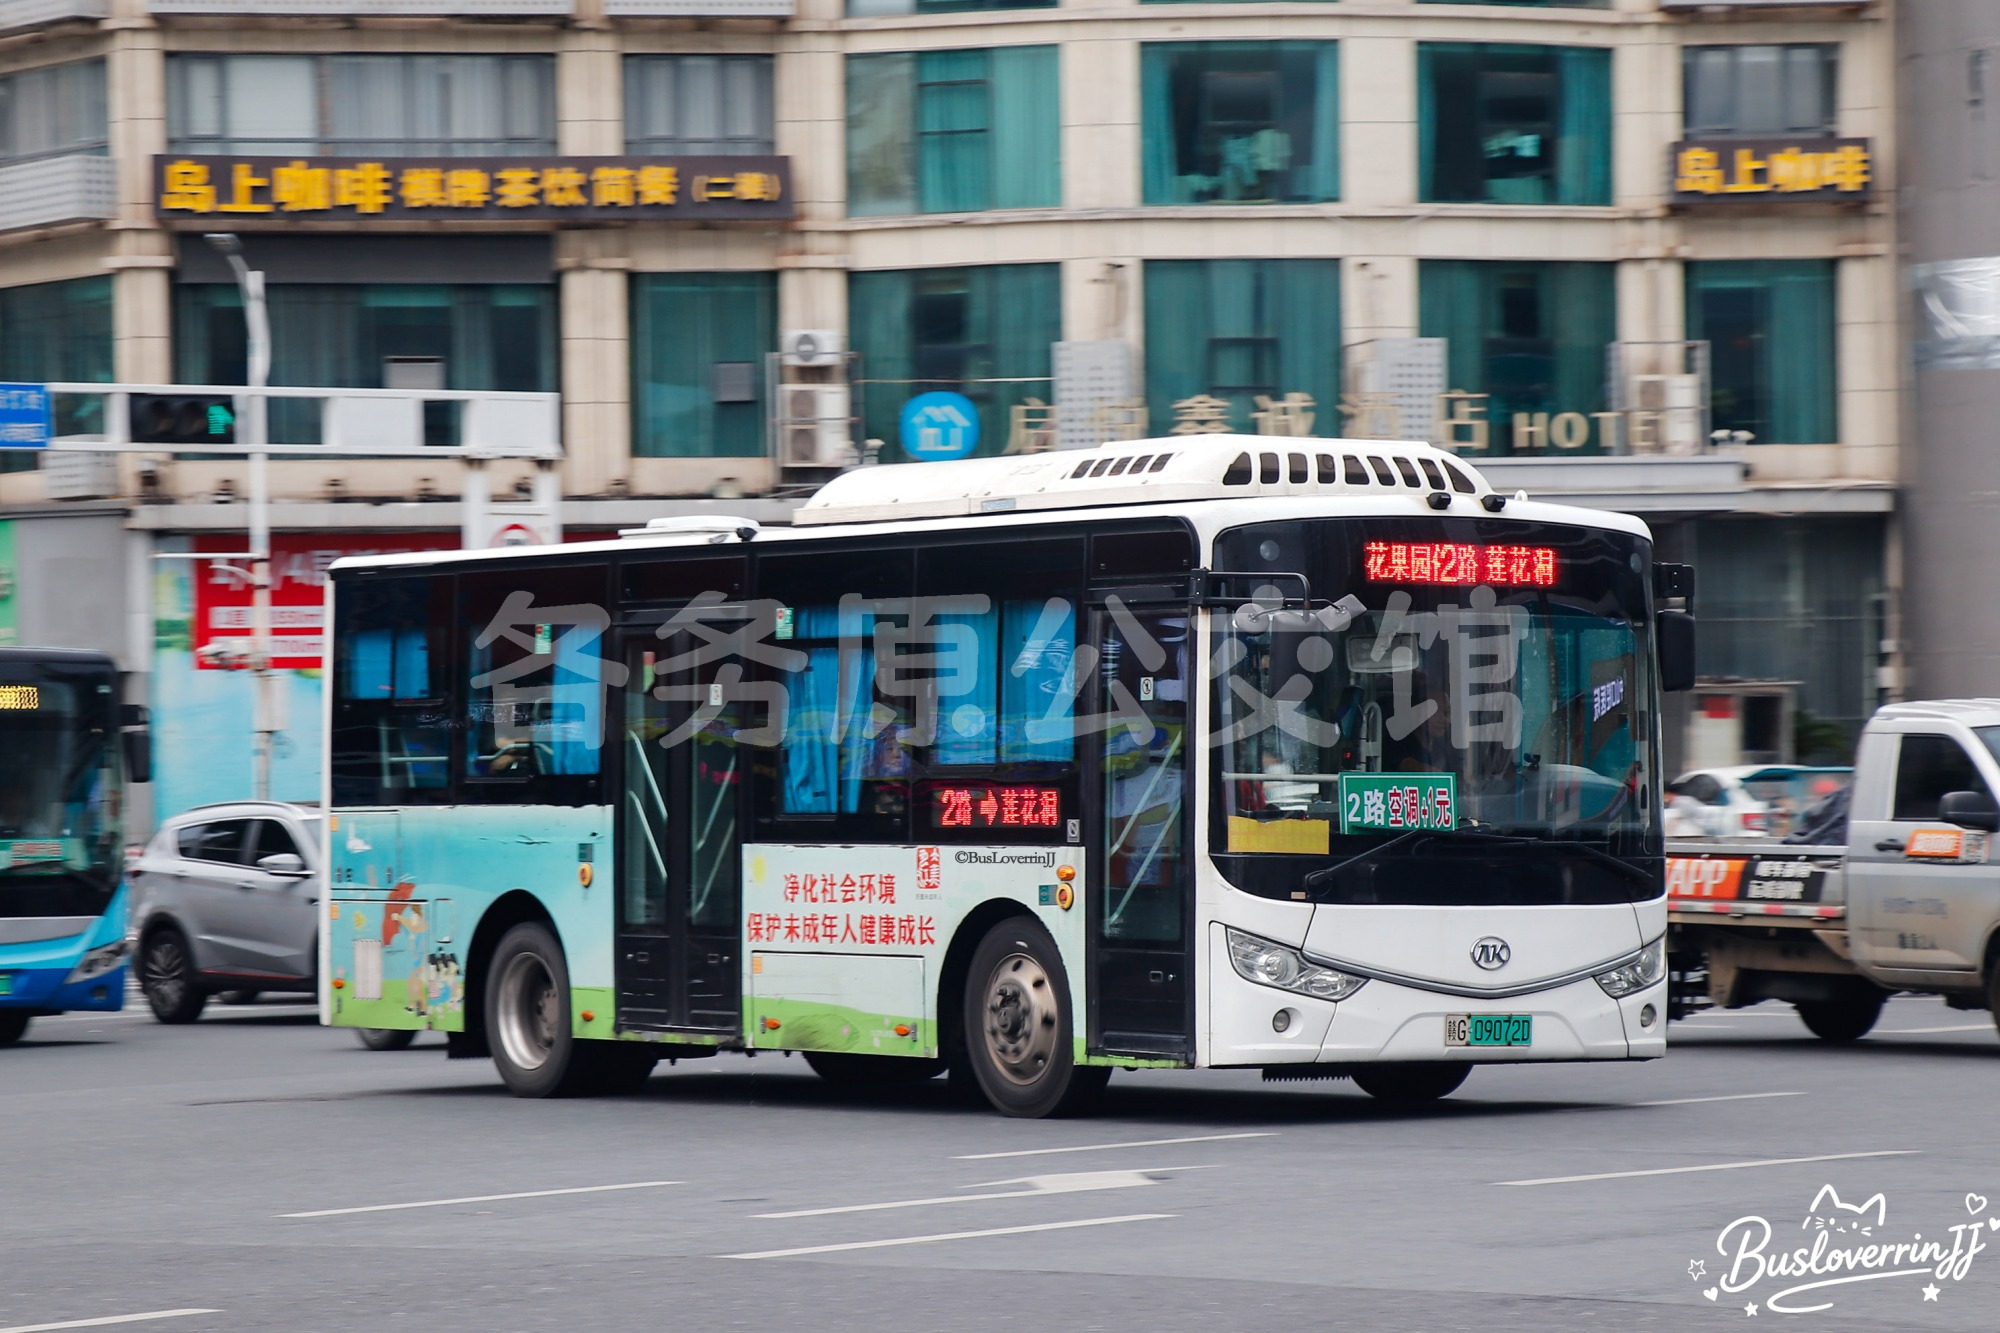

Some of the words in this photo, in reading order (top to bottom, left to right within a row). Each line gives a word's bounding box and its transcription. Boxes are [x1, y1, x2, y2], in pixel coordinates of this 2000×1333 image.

[161, 160, 394, 213] 岛上咖啡
[1675, 146, 1872, 194] 岛上咖啡
[784, 873, 896, 904] 净化社会环境
[747, 912, 936, 945] 保护未成年人健康成长
